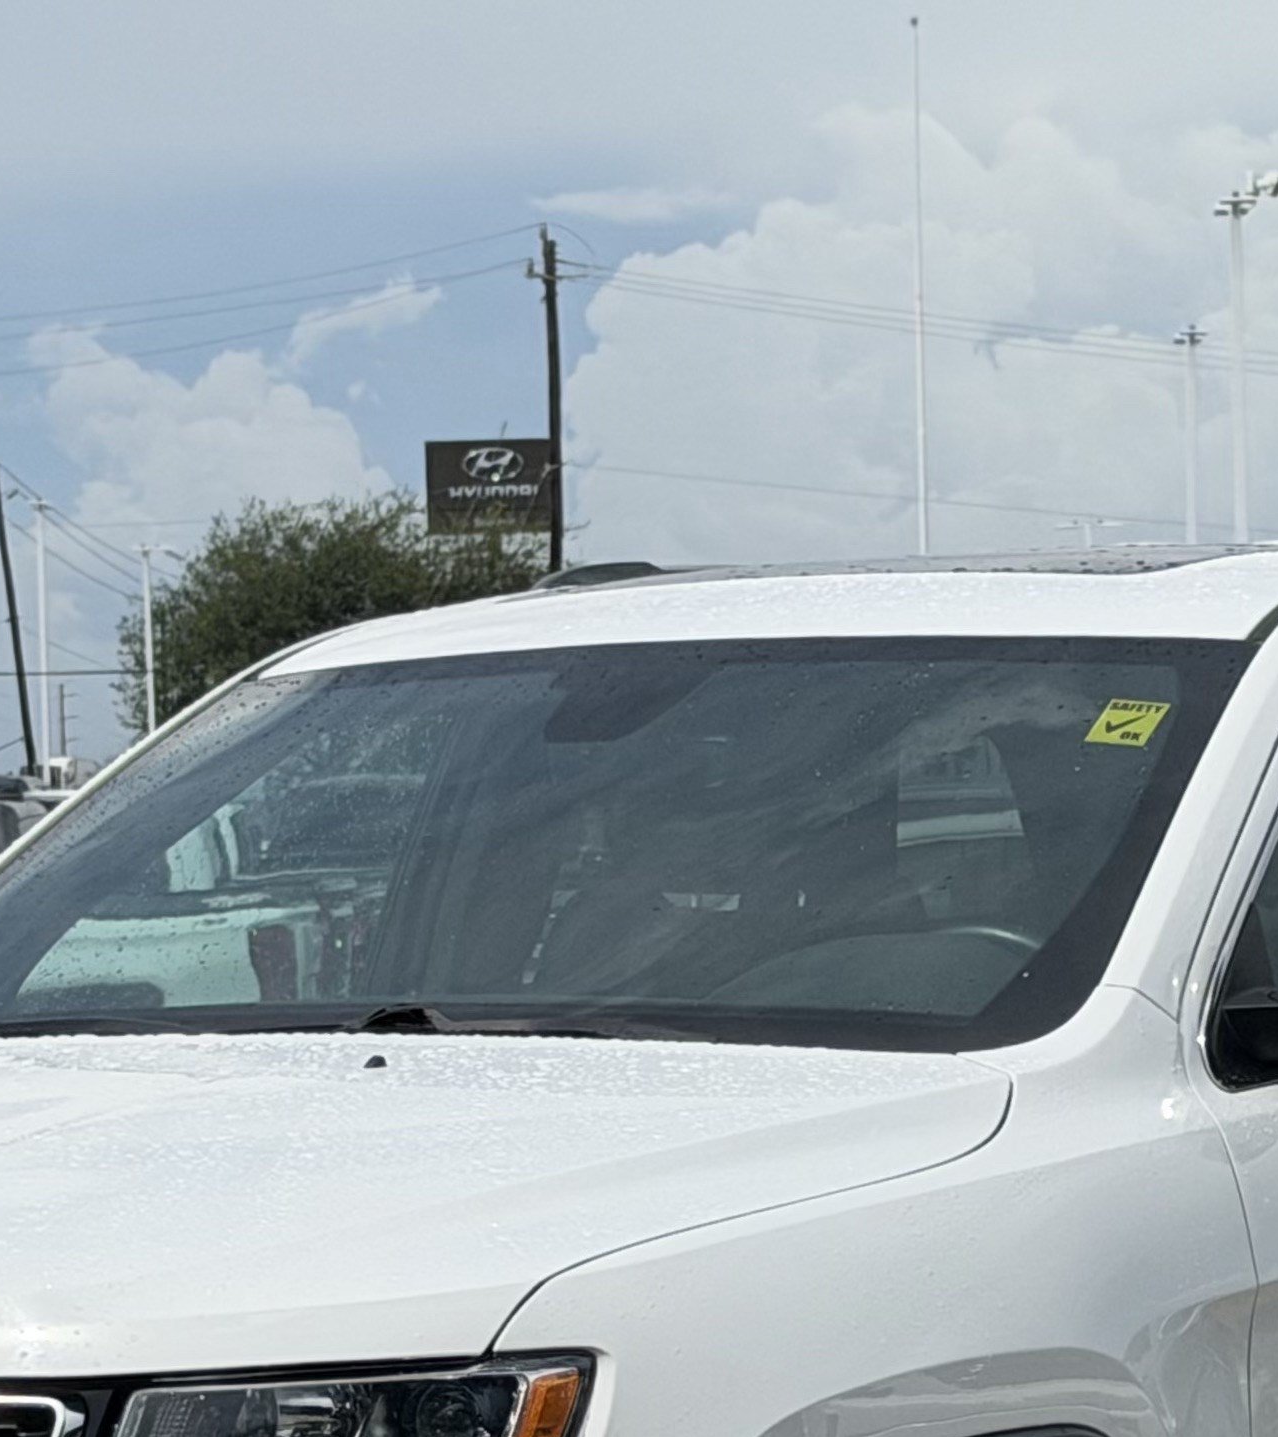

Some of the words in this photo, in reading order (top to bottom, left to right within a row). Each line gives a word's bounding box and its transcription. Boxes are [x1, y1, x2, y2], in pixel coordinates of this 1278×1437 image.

[447, 483, 539, 498] HYUNDAI
[1108, 702, 1165, 714] SAFETY
[1119, 731, 1142, 741] OK
